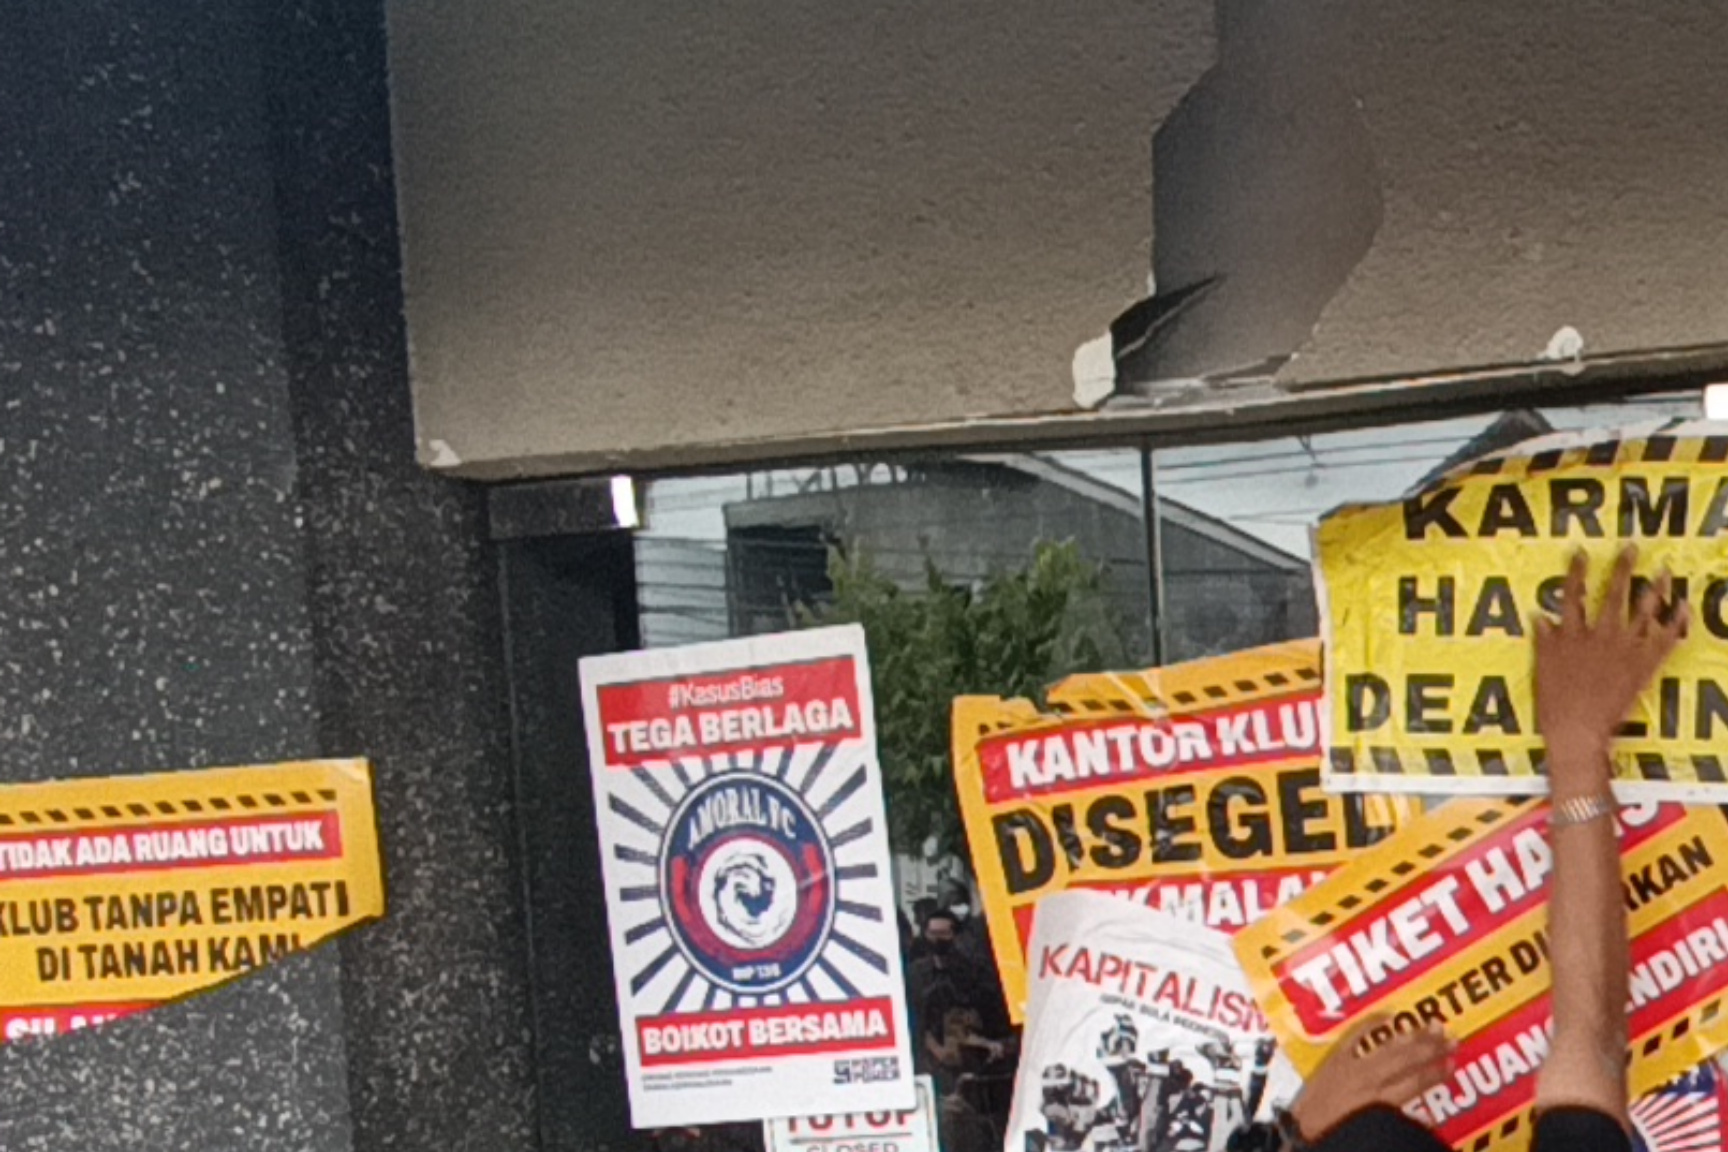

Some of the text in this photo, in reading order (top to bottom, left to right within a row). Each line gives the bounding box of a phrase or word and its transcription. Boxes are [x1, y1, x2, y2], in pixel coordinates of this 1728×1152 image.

[668, 676, 784, 709] #KasusBias
[608, 697, 855, 754] TEGA BERLAGA
[1006, 700, 1323, 790] KANTOR KLU
[0, 820, 325, 872] TIDAK ADA RUANG UNTUK
[84, 890, 202, 931] TANPA
[210, 880, 349, 923] EMPATI
[36, 946, 72, 982] DI
[78, 938, 200, 980] TANAH
[1291, 873, 1473, 1019] TIKET
[641, 1008, 888, 1056] BOIKOT BERSAMA
